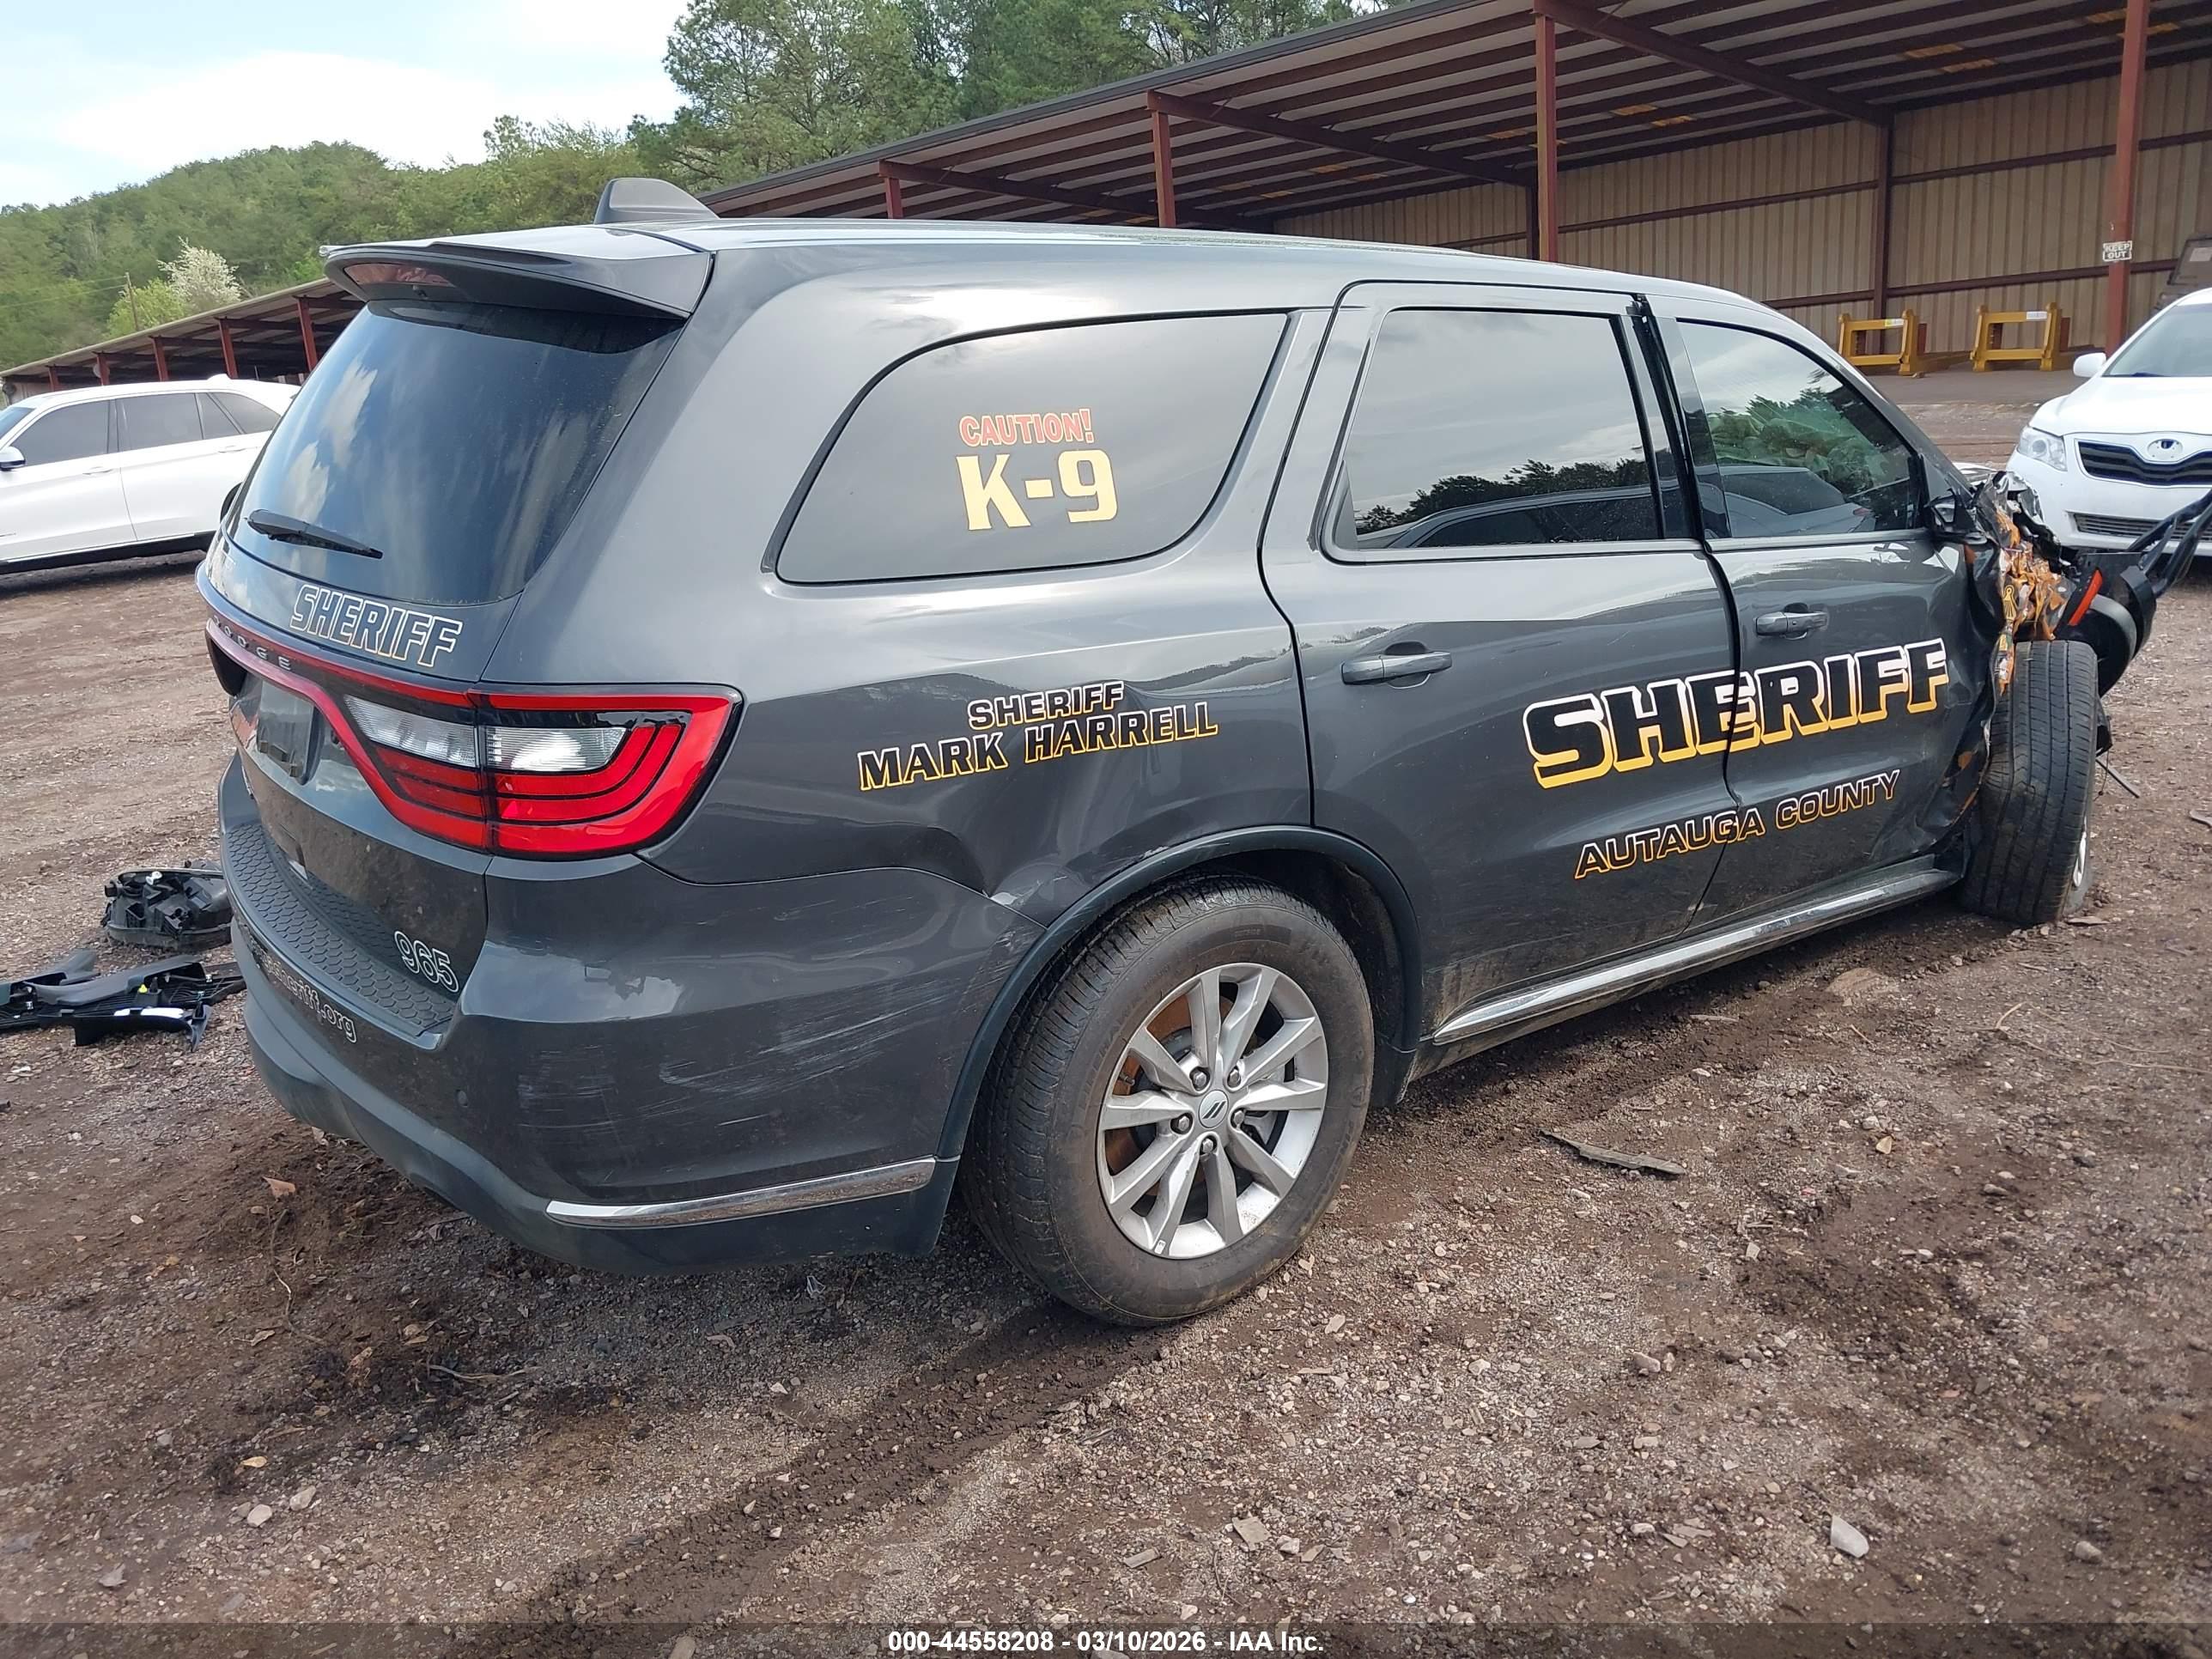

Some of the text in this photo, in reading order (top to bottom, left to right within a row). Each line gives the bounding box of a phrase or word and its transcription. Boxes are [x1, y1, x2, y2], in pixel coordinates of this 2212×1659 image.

[2106, 243, 2130, 252] KEEP
[2107, 251, 2126, 259] OUT
[959, 408, 1095, 447] CAUTION!
[956, 449, 1119, 532] K-9
[212, 615, 293, 671] DODGE
[289, 584, 463, 667] SHERIFF
[968, 681, 1124, 730] SHERIFF
[1523, 637, 1949, 789] SHERIFF
[857, 702, 1218, 791] MARK HARRELL
[1575, 769, 1901, 878] AUTAUGA COUNTY
[394, 930, 459, 993] 965
